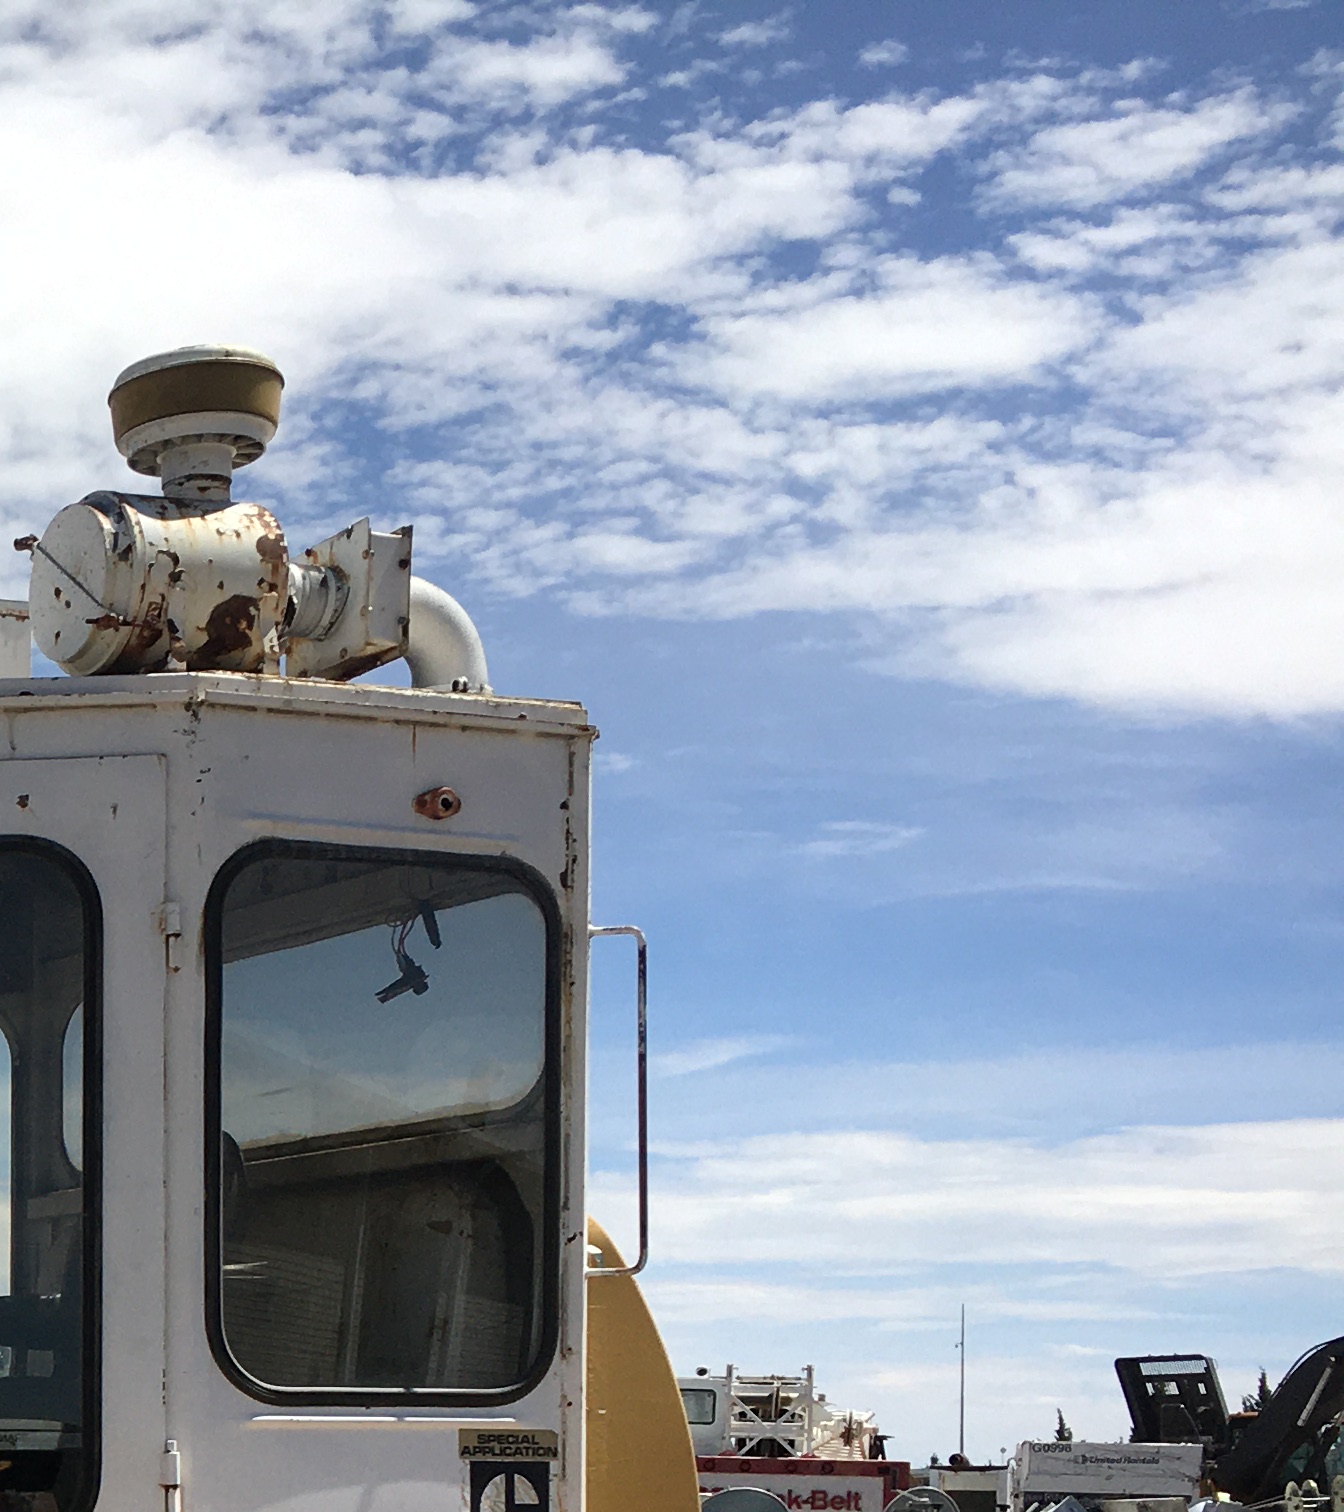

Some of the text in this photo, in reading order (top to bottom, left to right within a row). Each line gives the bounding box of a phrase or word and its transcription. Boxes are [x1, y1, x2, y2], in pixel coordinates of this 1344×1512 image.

[477, 1434, 539, 1444] SPECIAL
[461, 1446, 558, 1457] APPLICATION
[767, 1489, 862, 1512] k-Belt
